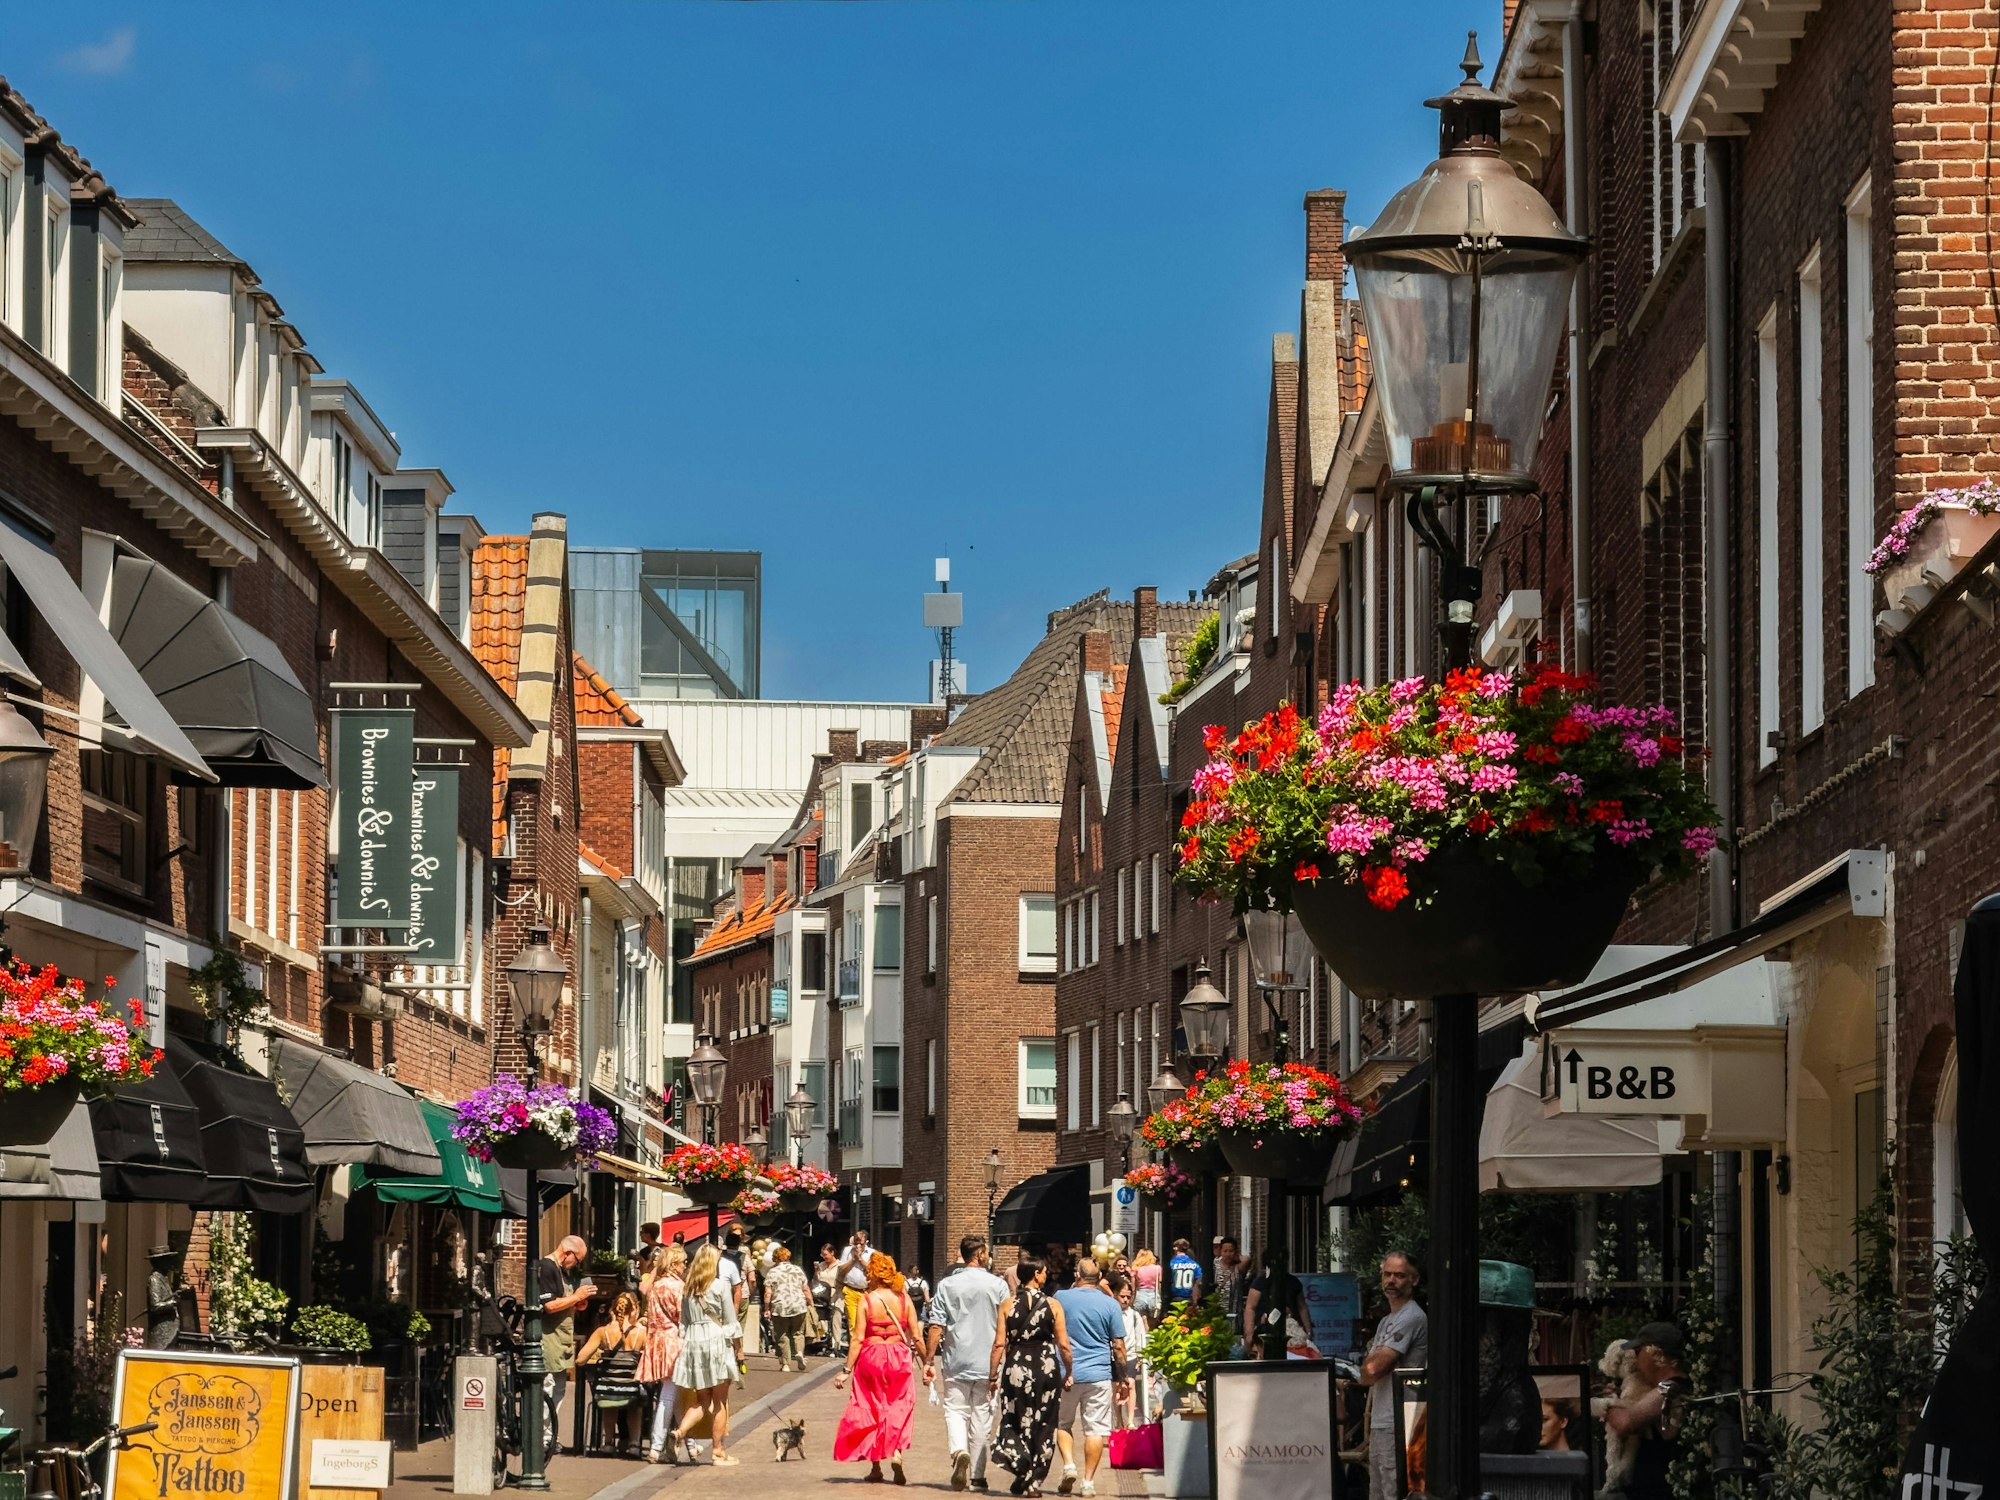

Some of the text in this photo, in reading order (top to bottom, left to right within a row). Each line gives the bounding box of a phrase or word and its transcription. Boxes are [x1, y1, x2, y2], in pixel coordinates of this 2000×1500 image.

[361, 728, 390, 805] Brownies
[357, 807, 393, 838] &
[411, 780, 437, 852] Brownies
[410, 853, 440, 880] &
[1588, 1066, 1676, 1100] B&B
[1174, 1269, 1194, 1289] 10
[163, 1387, 246, 1413] Janssen &
[301, 1391, 358, 1418] Open
[169, 1411, 240, 1436] Janssen
[171, 1434, 197, 1443] TATTOO
[206, 1437, 237, 1445] PIERCING
[1224, 1444, 1325, 1458] ANNAMOON
[152, 1452, 246, 1498] Tattoo
[1901, 1443, 1983, 1500] ritz
